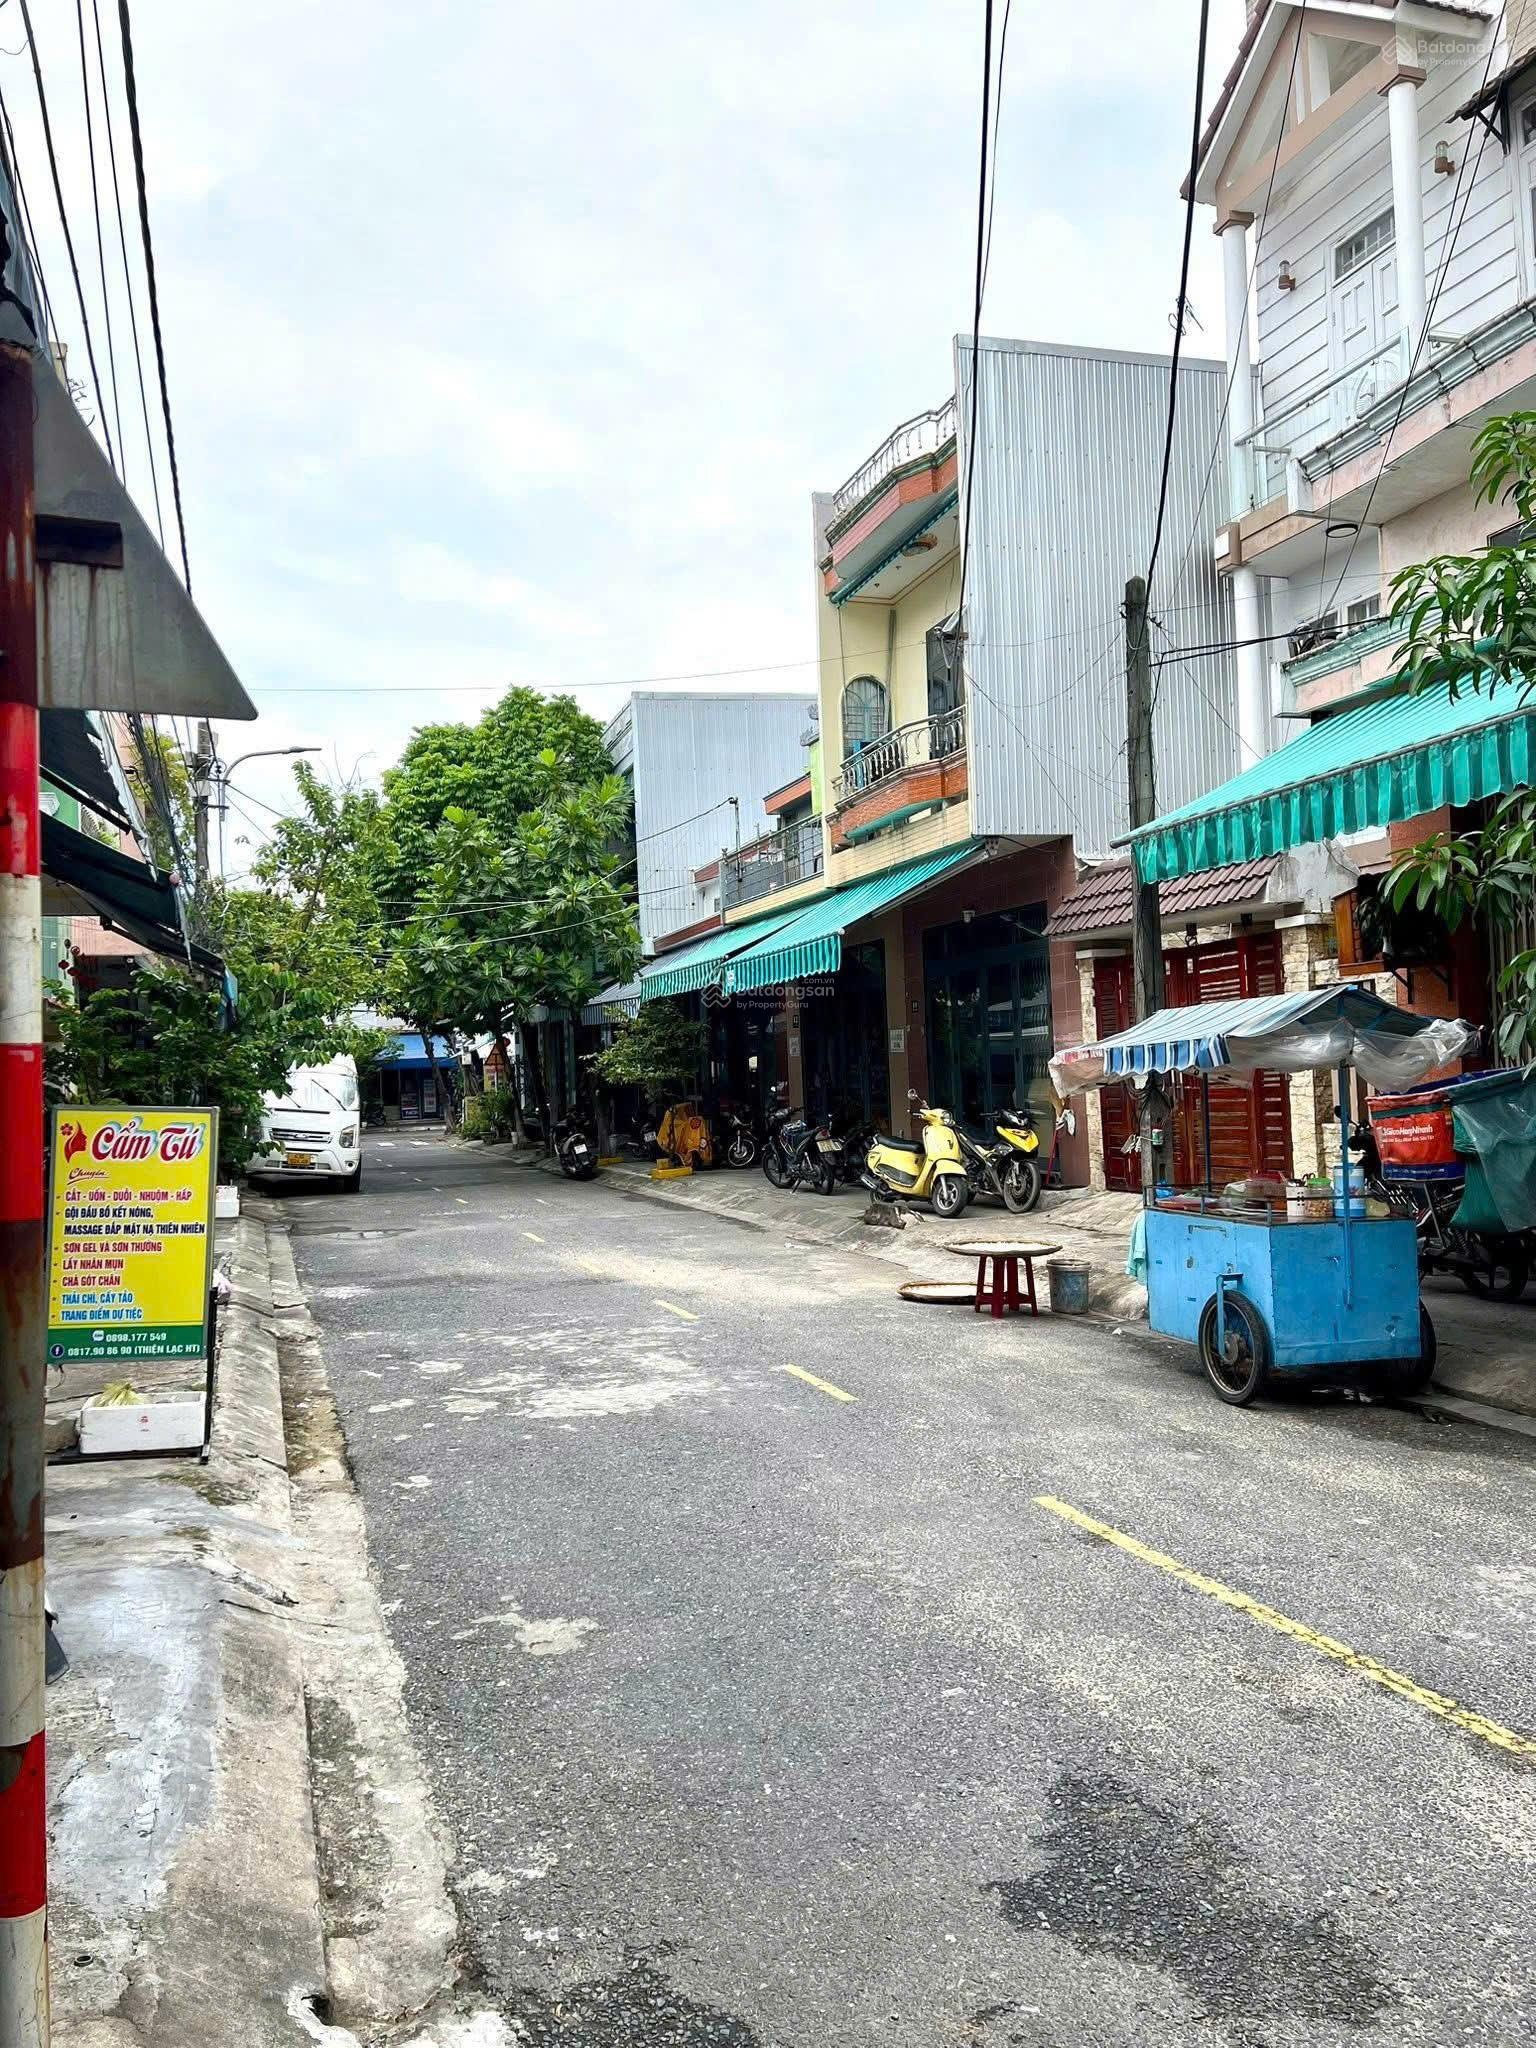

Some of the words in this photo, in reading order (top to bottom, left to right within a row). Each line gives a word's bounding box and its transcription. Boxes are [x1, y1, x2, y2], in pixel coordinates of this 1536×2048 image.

[91, 1119, 152, 1162] Cẩm
[159, 1126, 200, 1162] Tú
[175, 1189, 193, 1201] HẤP
[111, 1205, 127, 1218] KẾT
[64, 1224, 103, 1235] MASSAGE
[155, 1222, 179, 1234] THIÊN
[180, 1221, 206, 1234] NHIÊN
[63, 1241, 81, 1253] SƠN
[82, 1242, 98, 1253] GEL
[111, 1241, 129, 1252] SƠN
[62, 1256, 79, 1270] LẤY
[104, 1258, 125, 1271] MỤN
[80, 1274, 97, 1287] GÓT
[61, 1310, 88, 1321] TRANG
[105, 1331, 147, 1343] 0898.177
[149, 1331, 168, 1342] 549
[67, 1347, 104, 1357] 0817.90
[106, 1346, 119, 1356] 86
[120, 1346, 132, 1355] 90
[185, 1343, 201, 1354] HT)
